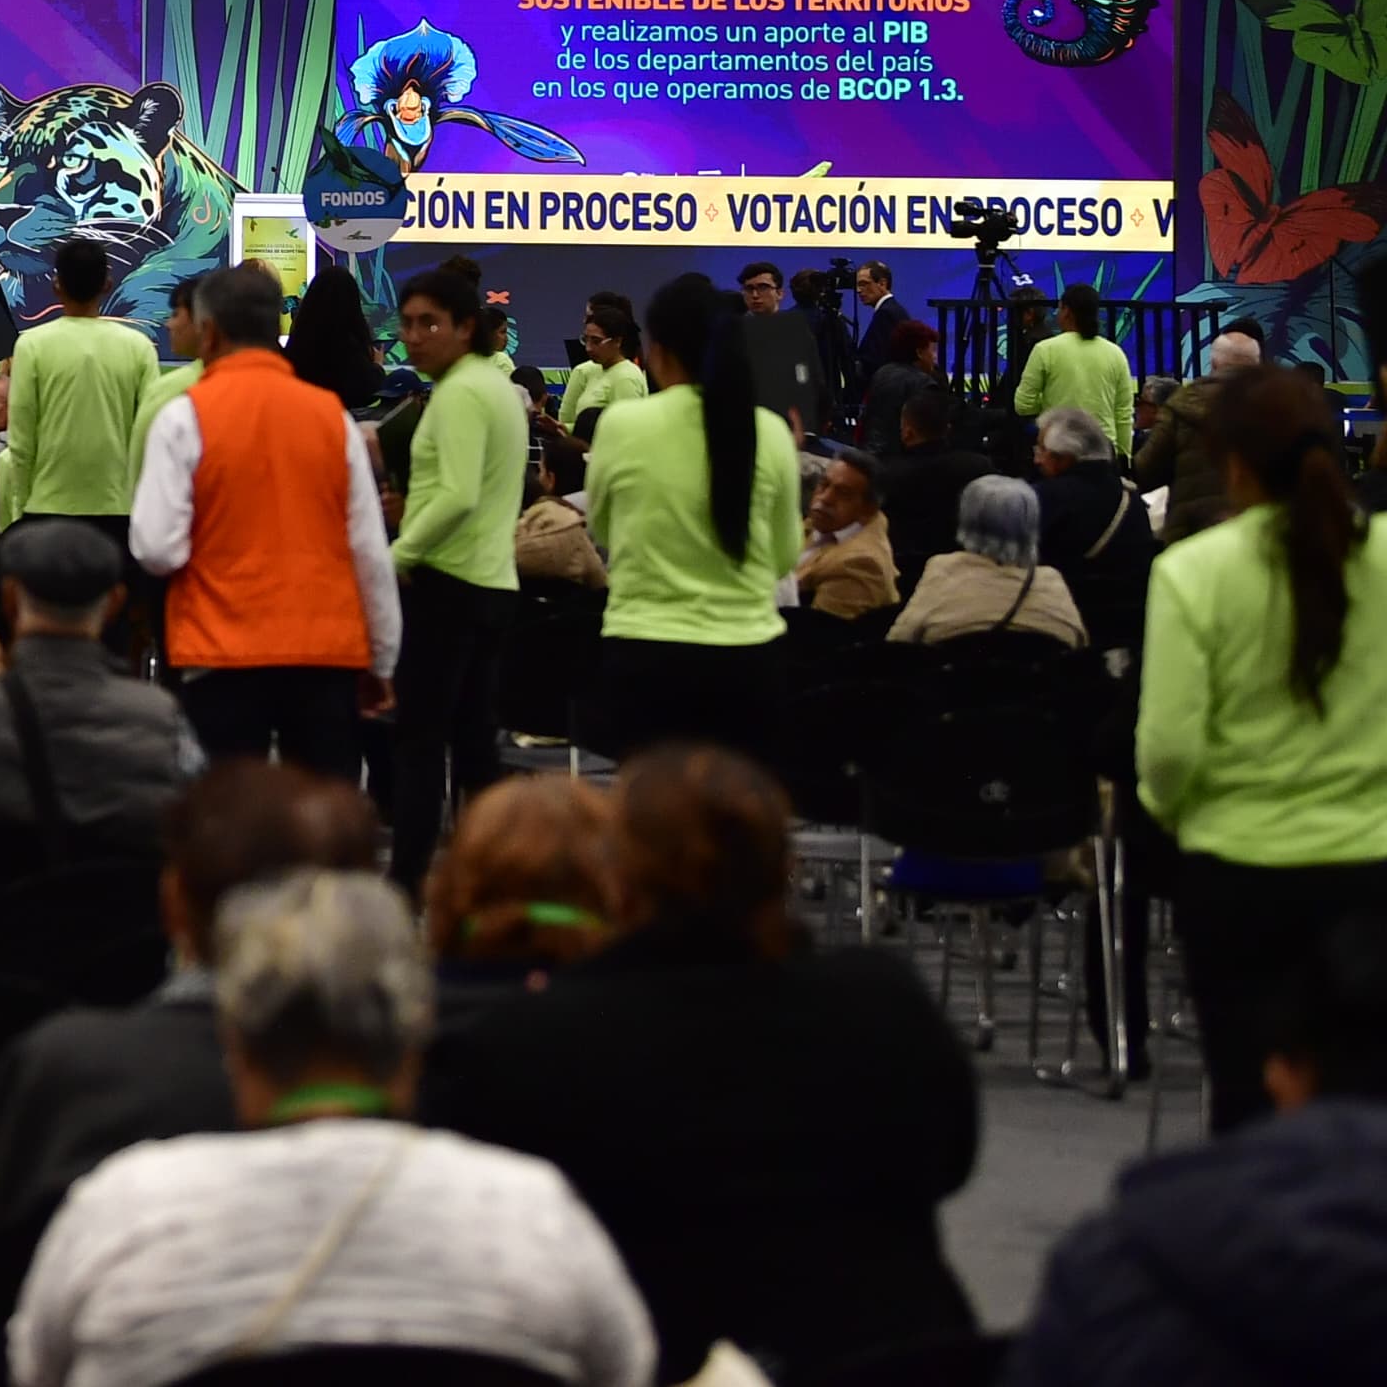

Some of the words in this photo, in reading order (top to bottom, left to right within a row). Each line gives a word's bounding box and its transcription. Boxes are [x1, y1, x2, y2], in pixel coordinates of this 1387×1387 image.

[560, 25, 575, 47] y
[581, 19, 719, 42] realizamos
[726, 26, 757, 43] un
[764, 22, 846, 49] aporte
[852, 20, 877, 44] al
[883, 20, 928, 44] PIB
[556, 47, 587, 70] de
[594, 47, 630, 70] los
[637, 48, 829, 77] departamentos
[836, 49, 875, 72] del
[882, 49, 934, 78] país
[532, 81, 562, 98] en
[570, 75, 606, 98] los
[613, 81, 659, 104] que
[666, 82, 794, 105] operamos
[800, 77, 831, 100] de
[838, 78, 912, 101] BCOP
[919, 78, 964, 101] 1.3.
[320, 190, 386, 207] FONDOS
[485, 190, 530, 230] EN
[539, 191, 698, 232] PROCESO
[726, 181, 896, 234] VOTACIÓN
[906, 195, 953, 235] EN
